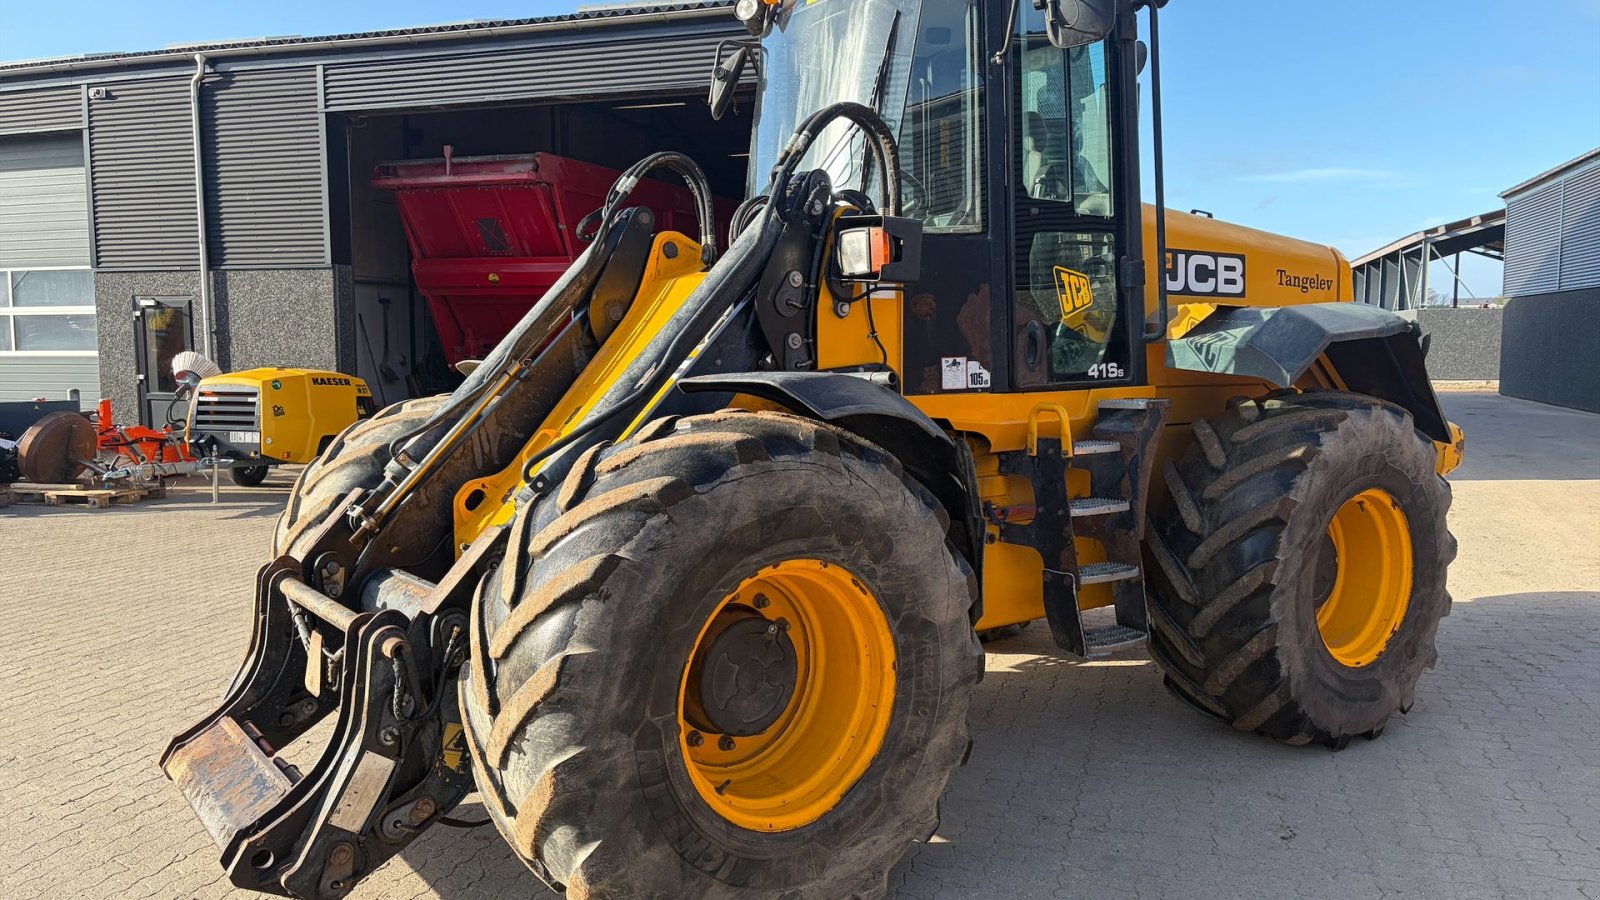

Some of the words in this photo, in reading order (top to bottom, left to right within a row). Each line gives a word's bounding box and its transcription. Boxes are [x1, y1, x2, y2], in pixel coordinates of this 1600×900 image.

[1166, 254, 1244, 293] JCB
[1276, 269, 1333, 293] Tangelev
[1061, 272, 1091, 313] JCB
[312, 377, 351, 386] KAESER
[970, 373, 984, 386] 105
